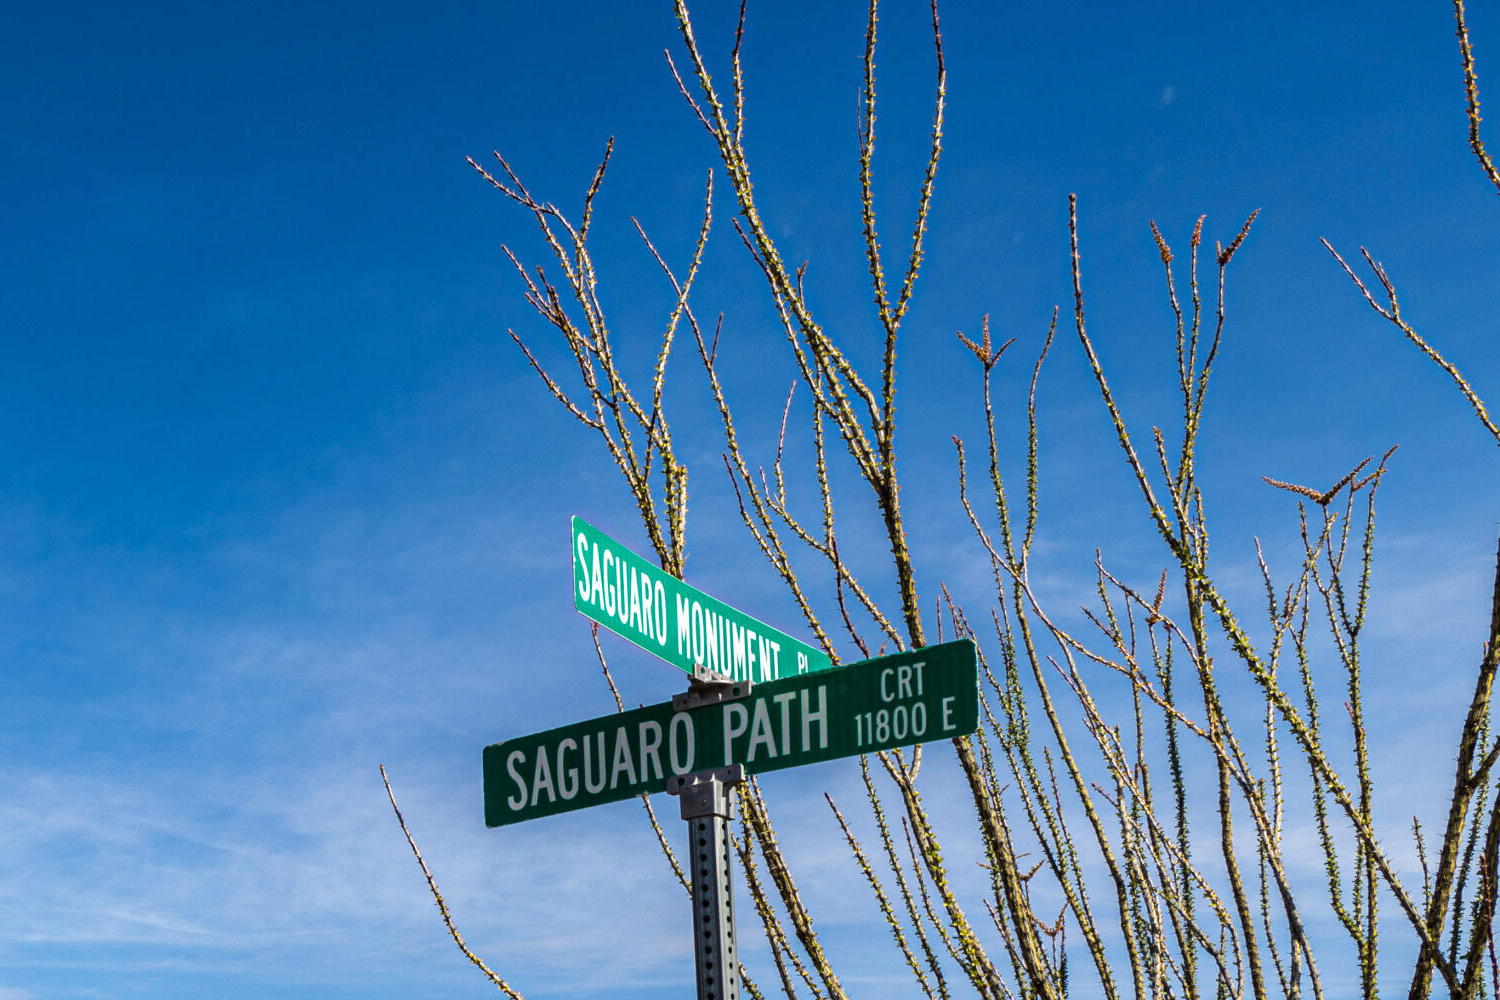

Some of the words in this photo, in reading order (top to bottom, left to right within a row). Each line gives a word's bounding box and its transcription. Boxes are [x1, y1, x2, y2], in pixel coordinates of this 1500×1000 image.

[576, 532, 667, 646] SAGUARO
[676, 593, 780, 682] MONUMENT
[854, 702, 927, 748] 11800
[942, 697, 957, 731] E
[880, 662, 926, 702] CRT
[507, 712, 695, 811] SAGUARO
[723, 685, 828, 766] PATH
